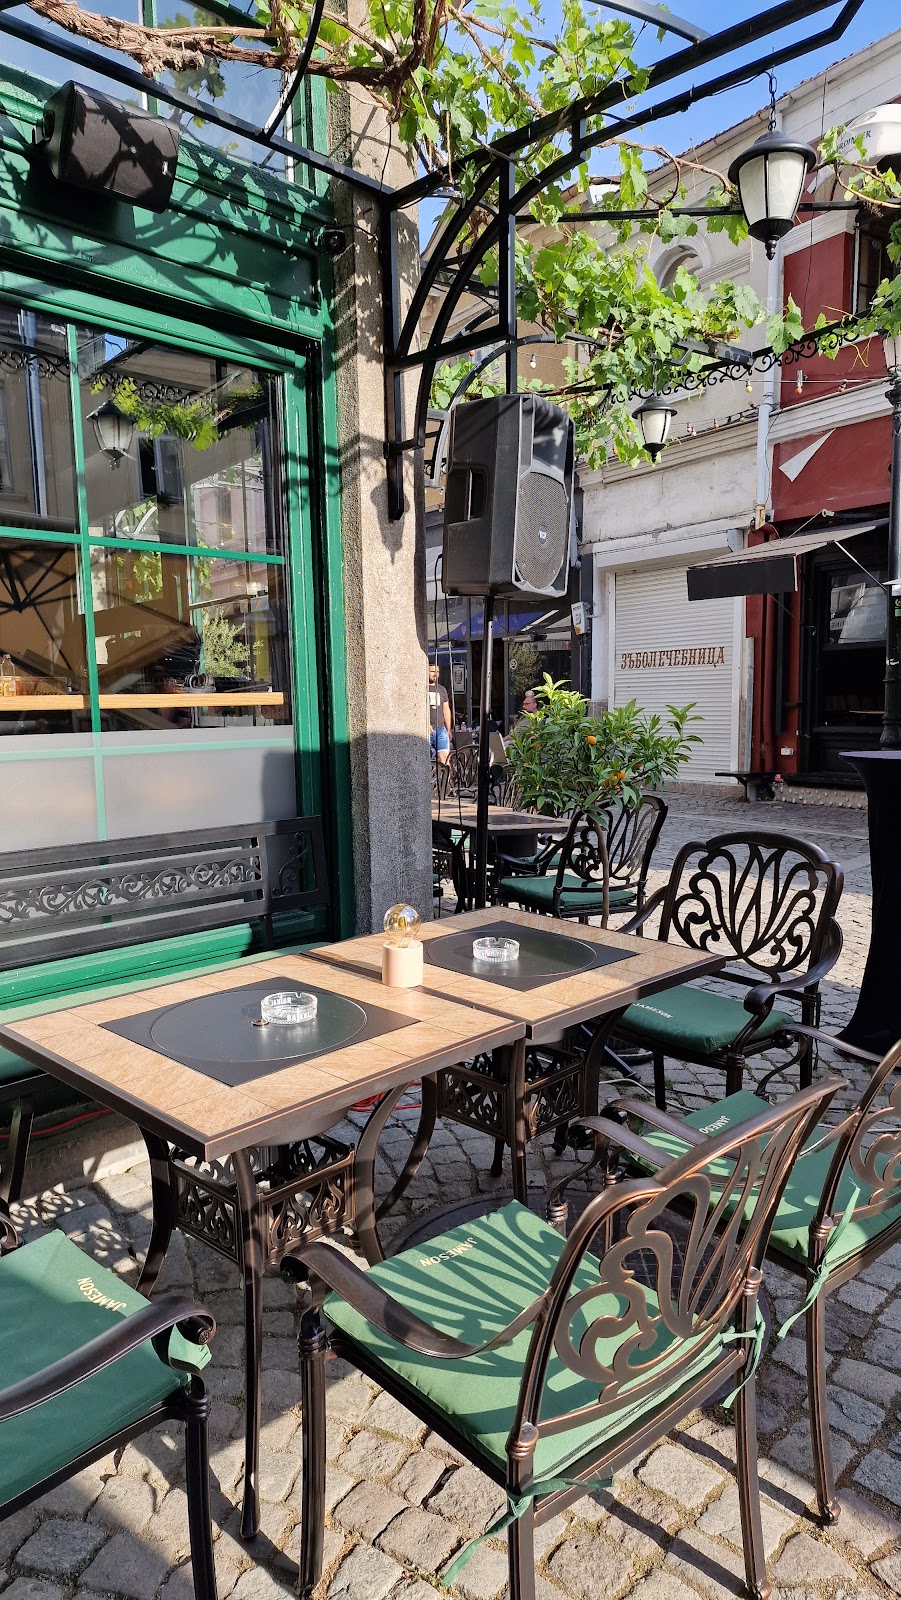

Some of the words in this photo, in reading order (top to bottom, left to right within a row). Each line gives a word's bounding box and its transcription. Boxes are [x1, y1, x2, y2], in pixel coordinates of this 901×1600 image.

[620, 646, 725, 669] ЗЪБОЛЕЧЕБНИЦА
[632, 1002, 673, 1019] JAMESON
[698, 1115, 731, 1134] JAMESO
[420, 1236, 477, 1267] JAMESON
[77, 1276, 128, 1312] JAMESON
